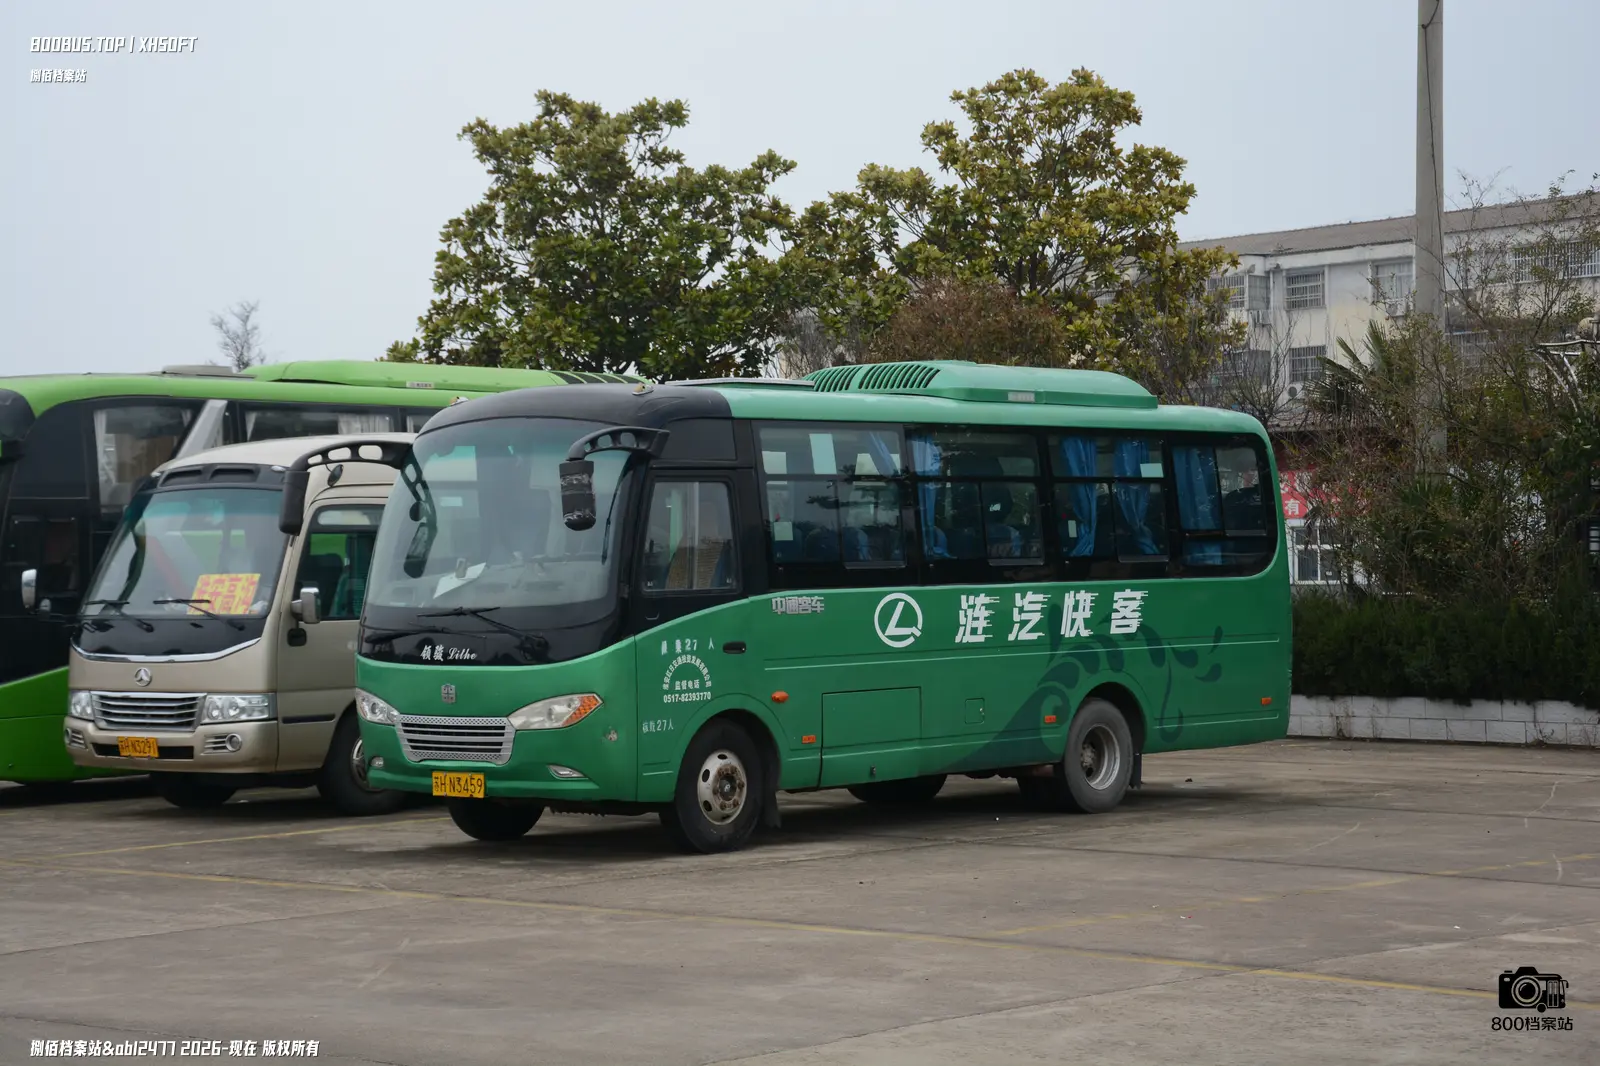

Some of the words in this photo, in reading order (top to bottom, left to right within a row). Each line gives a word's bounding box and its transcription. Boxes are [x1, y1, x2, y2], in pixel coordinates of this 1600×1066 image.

[771, 596, 825, 614] 中通客车
[954, 588, 1149, 643] 涟汽快客
